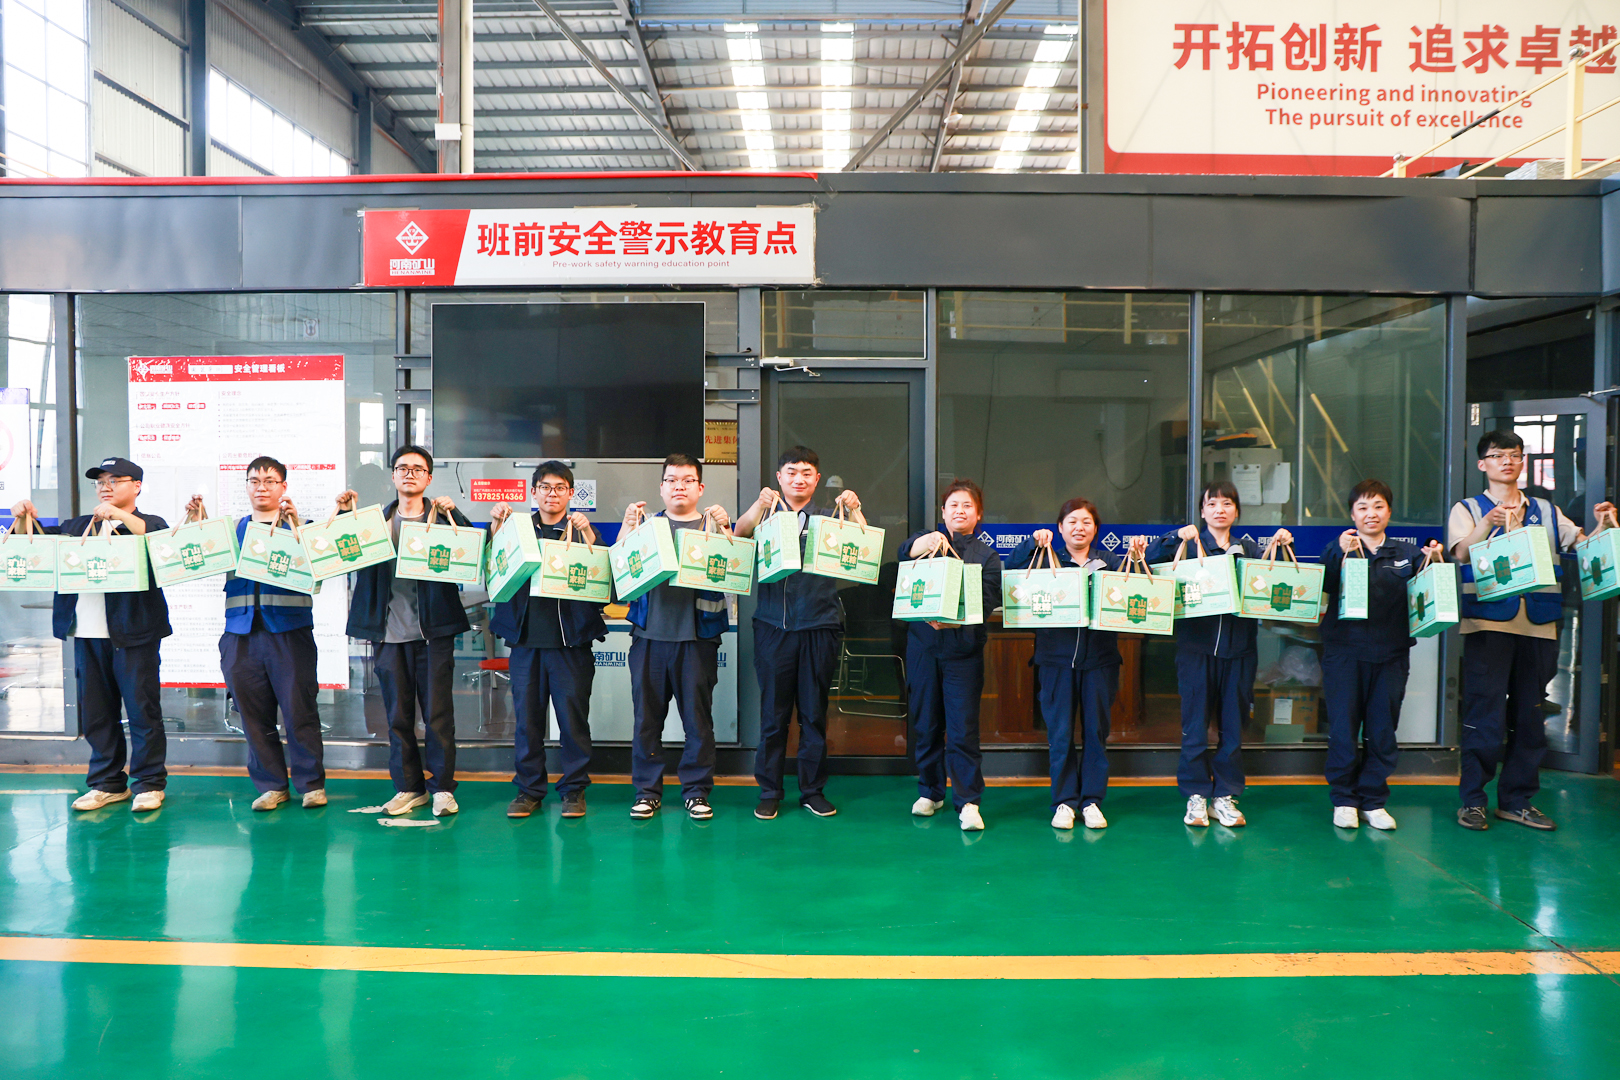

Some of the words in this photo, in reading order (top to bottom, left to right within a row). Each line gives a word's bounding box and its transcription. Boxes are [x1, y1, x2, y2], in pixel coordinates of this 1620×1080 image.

[1173, 21, 1382, 73] 开拓创新
[1408, 23, 1618, 75] 追求卓越
[1257, 83, 1371, 106] Pioneering
[1376, 84, 1414, 102] and
[1421, 84, 1533, 108] innovating
[1265, 108, 1303, 126] The
[1310, 108, 1385, 130] pursuit
[1390, 109, 1412, 127] of
[1416, 110, 1524, 129] excellence
[476, 220, 798, 257] 班前安全警示教育点
[389, 258, 435, 270] 河南矿山
[552, 260, 593, 268] Pre-work
[595, 260, 622, 269] safety
[624, 260, 659, 269] warning
[707, 260, 730, 269] point
[234, 363, 286, 374] 安全管理看板
[473, 492, 524, 501] 13782514366
[338, 537, 358, 548] 矿山
[430, 548, 450, 558] 矿山
[842, 545, 858, 556] 矿山
[271, 553, 290, 564] 矿山
[709, 557, 726, 568] 矿山
[570, 567, 587, 576] 矿山
[1129, 598, 1147, 608] 矿山
[593, 651, 626, 661] 南矿山
